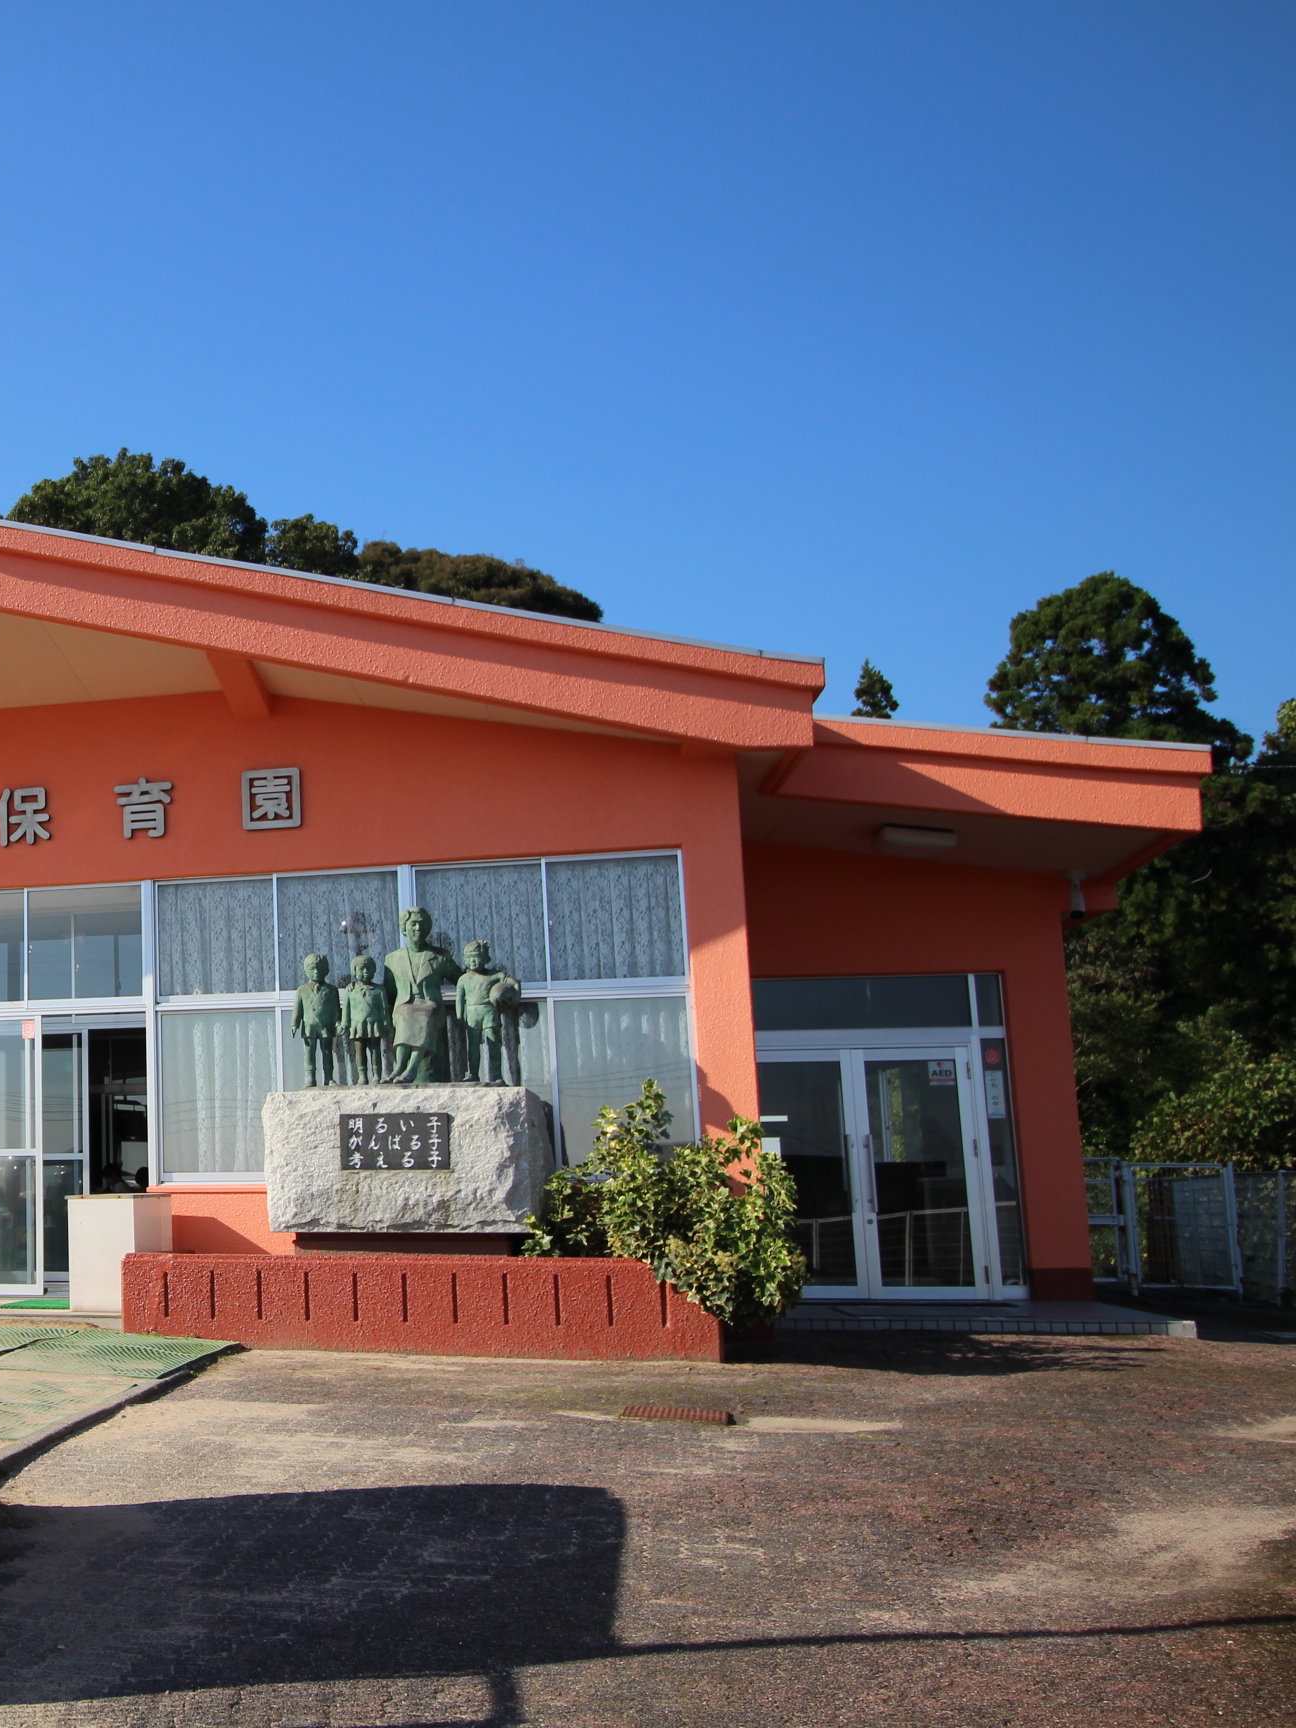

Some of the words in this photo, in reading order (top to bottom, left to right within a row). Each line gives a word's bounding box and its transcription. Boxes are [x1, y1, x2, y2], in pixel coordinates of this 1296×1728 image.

[931, 1069, 952, 1077] AED
[347, 1116, 443, 1133] 明るい子
[347, 1134, 443, 1151] がんばる子
[347, 1151, 443, 1168] 考える子
